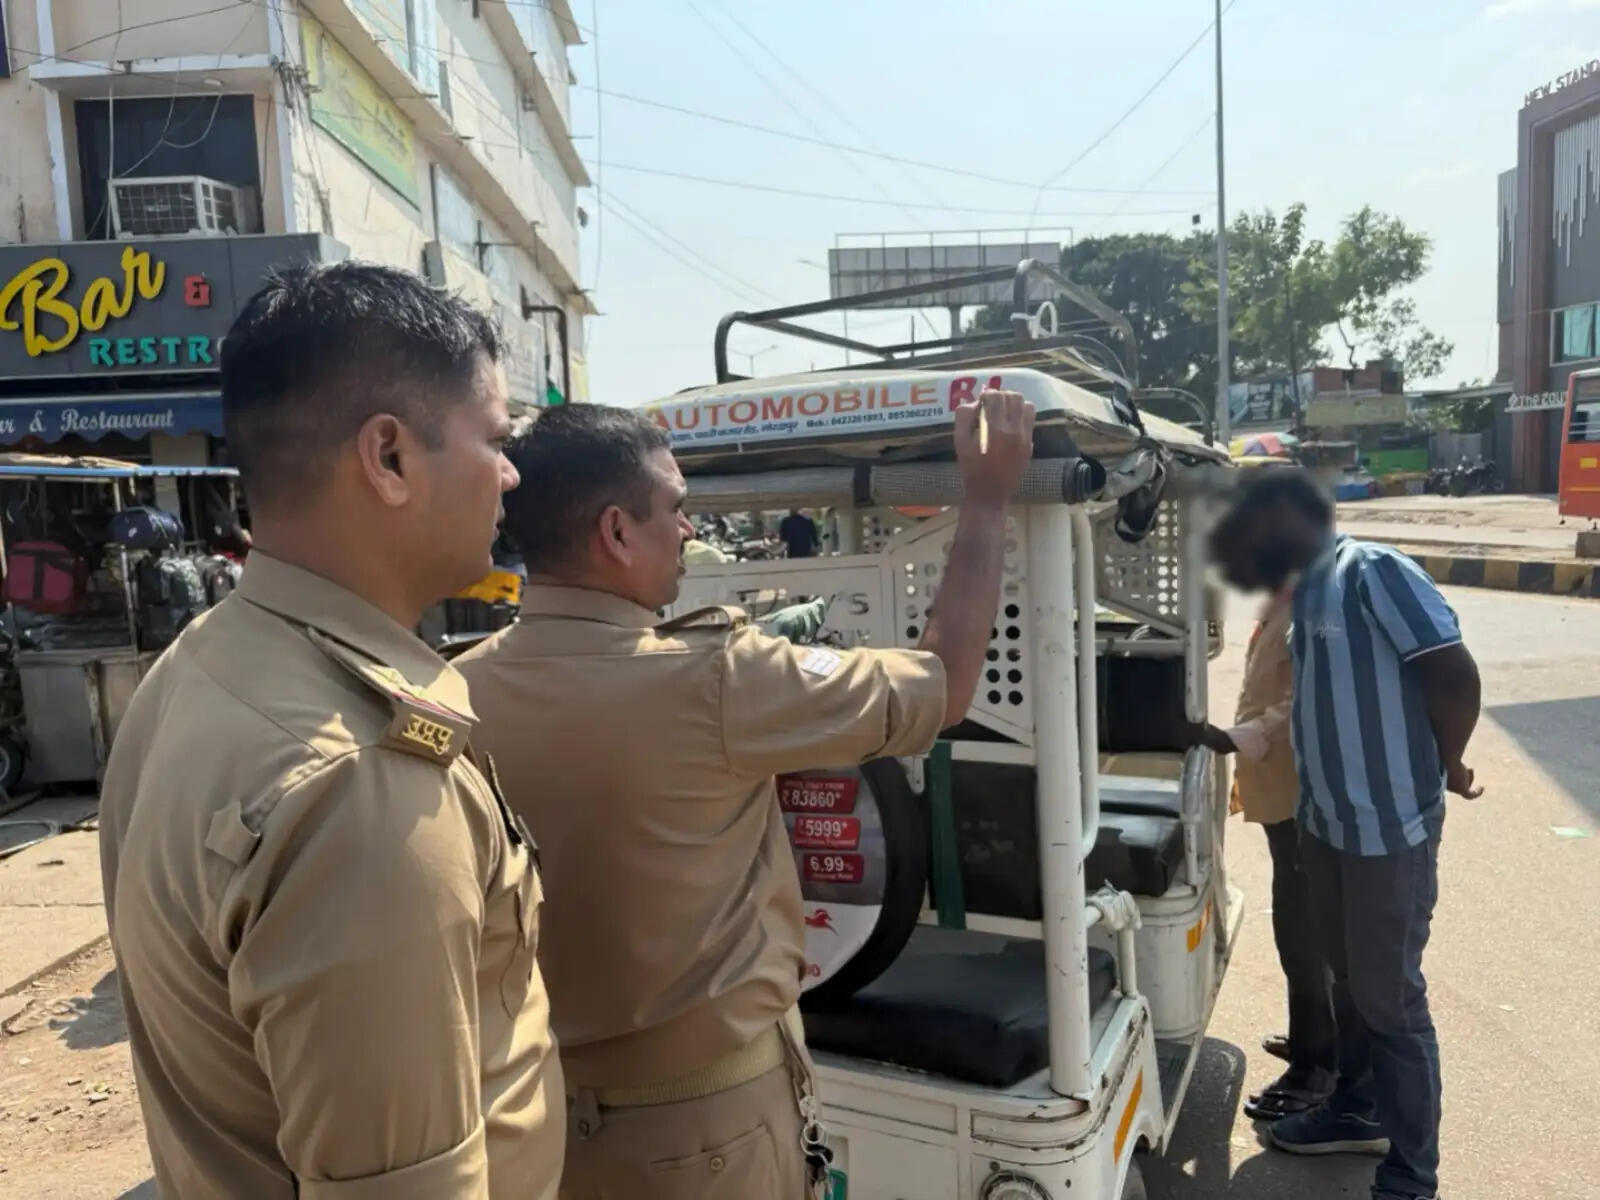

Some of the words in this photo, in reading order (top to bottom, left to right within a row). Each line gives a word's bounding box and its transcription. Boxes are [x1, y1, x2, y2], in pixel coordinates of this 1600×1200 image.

[1524, 81, 1551, 105] NEW
[0, 246, 166, 357] Bar
[184, 273, 210, 307] &
[88, 335, 226, 367] RESTR
[29, 408, 46, 433] &
[60, 407, 175, 432] Restaurant
